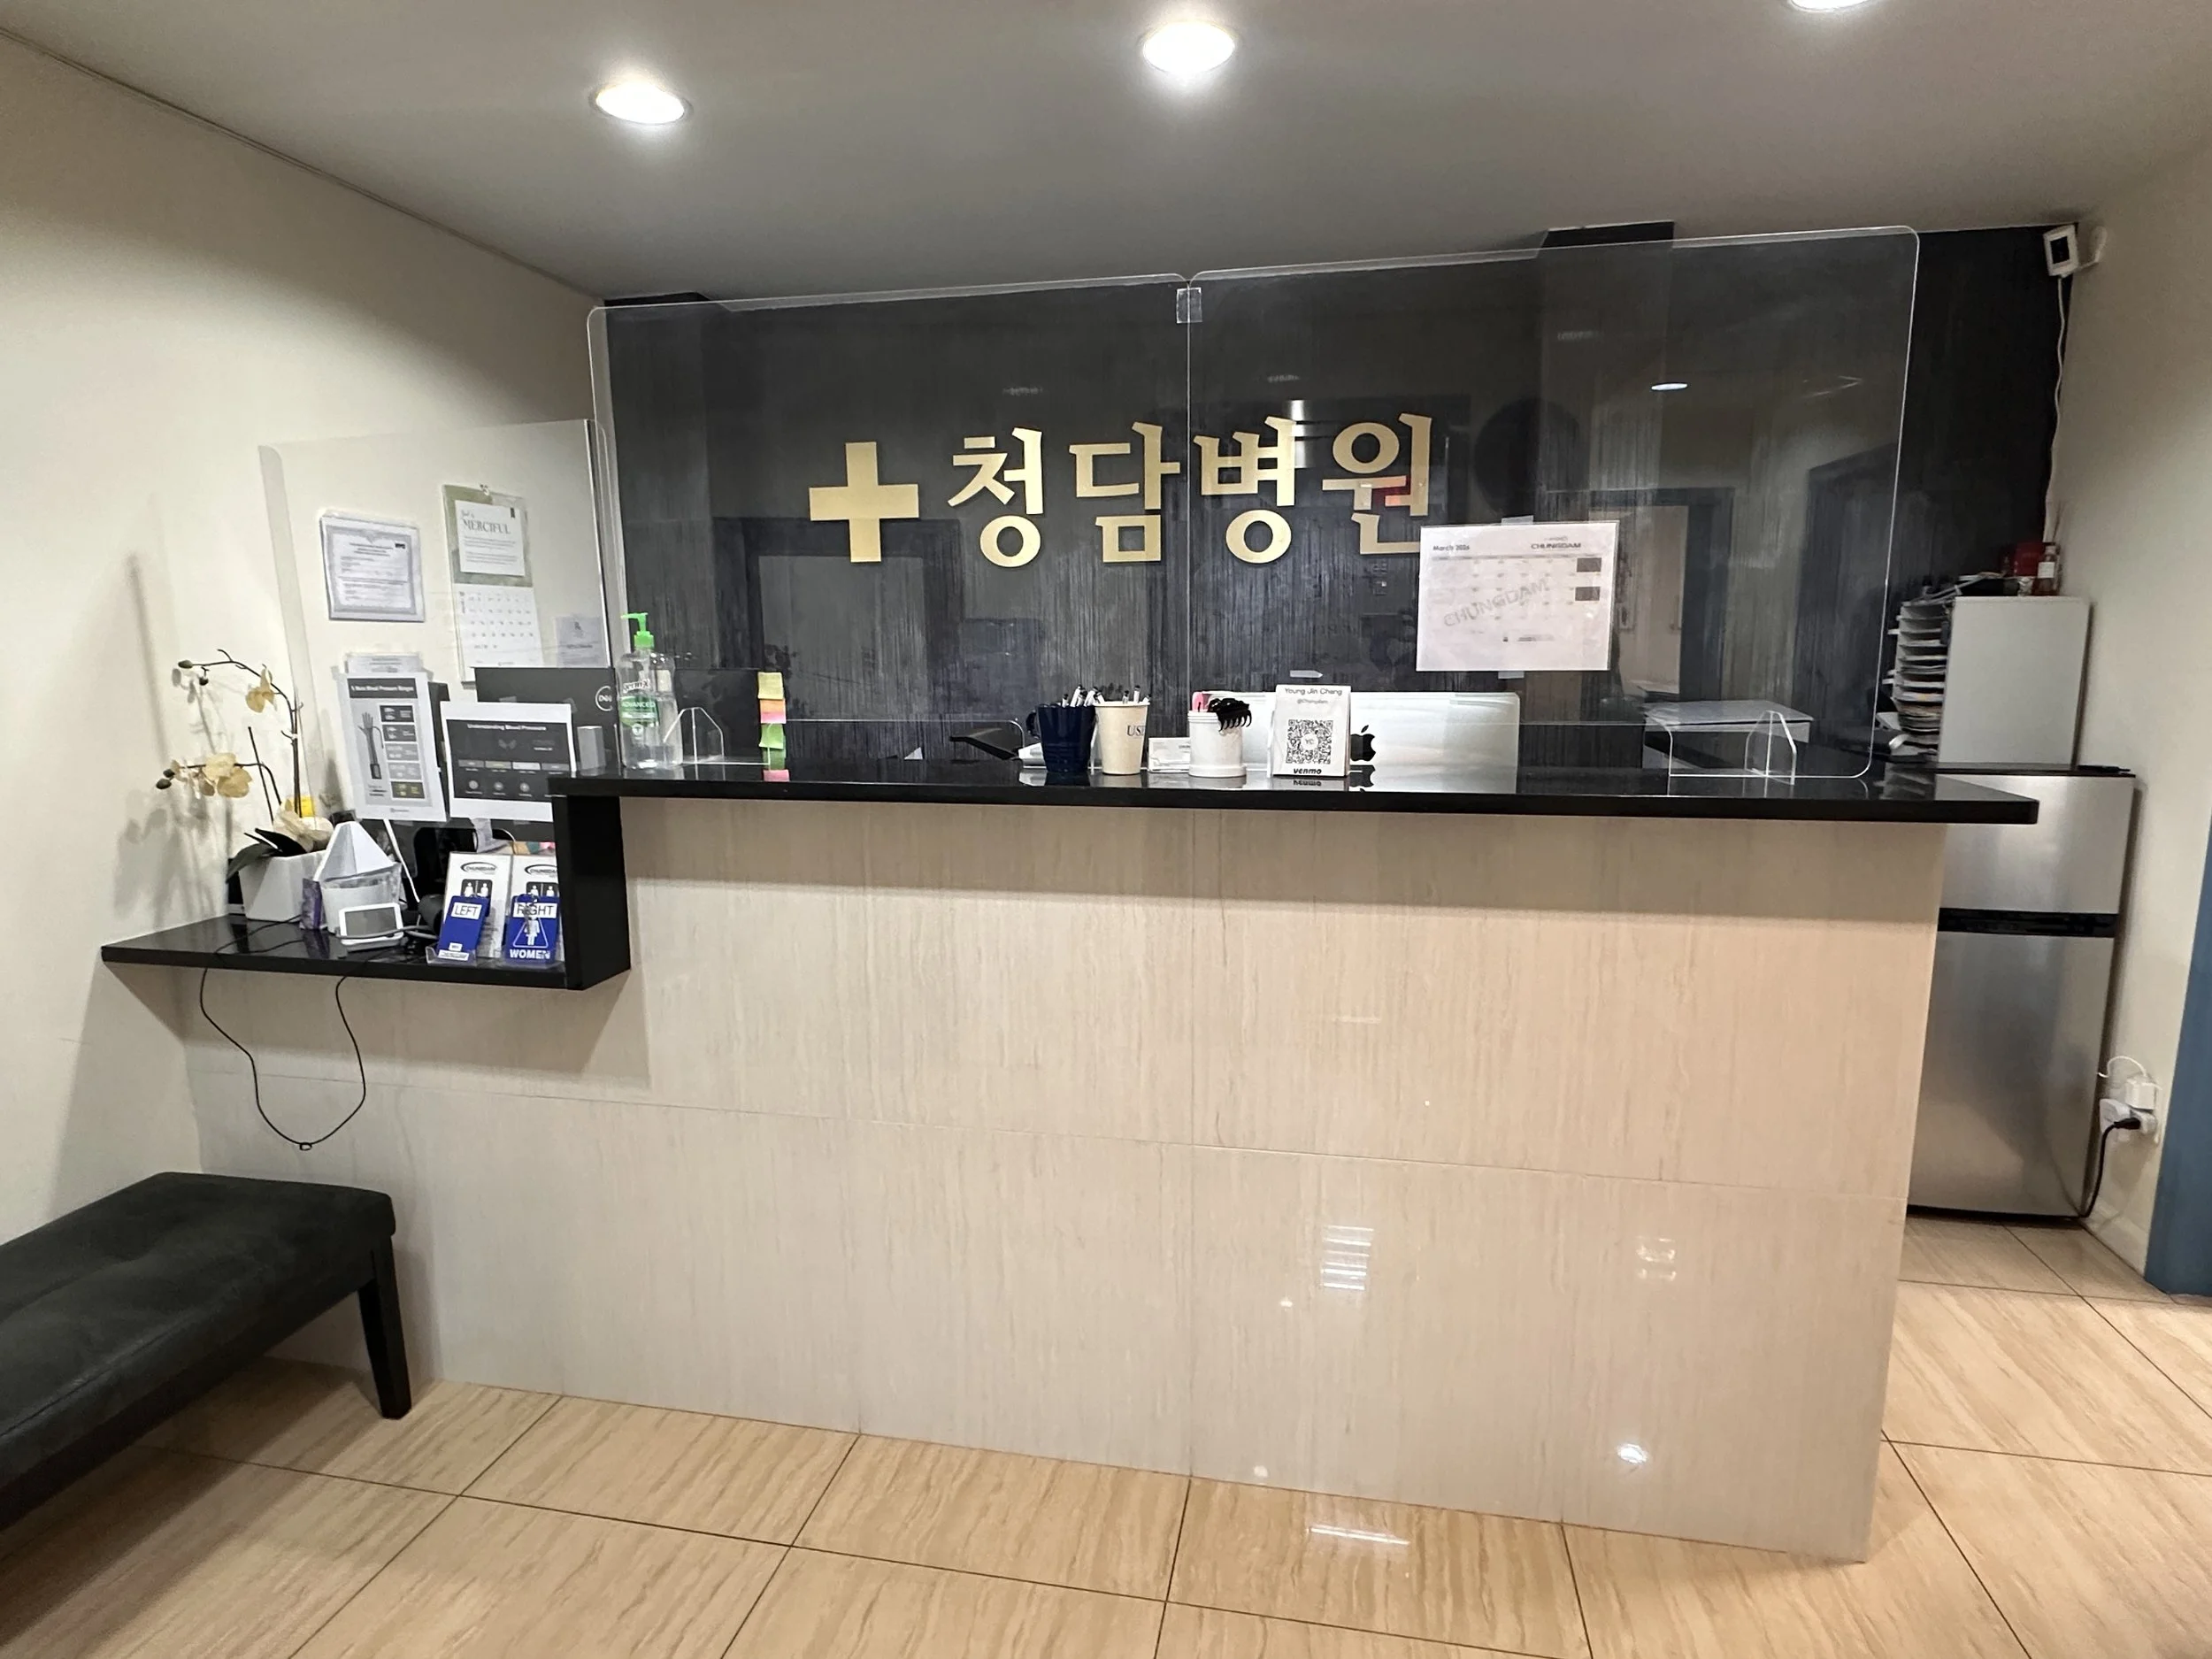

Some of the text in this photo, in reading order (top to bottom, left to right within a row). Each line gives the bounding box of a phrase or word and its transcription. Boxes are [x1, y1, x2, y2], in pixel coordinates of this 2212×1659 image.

[947, 411, 1433, 568] 청담병원
[461, 518, 511, 534] MERCIFUL
[1443, 579, 1548, 628] CHUNGDAM
[454, 902, 480, 917] LEFT
[509, 949, 550, 960] WOMEN
